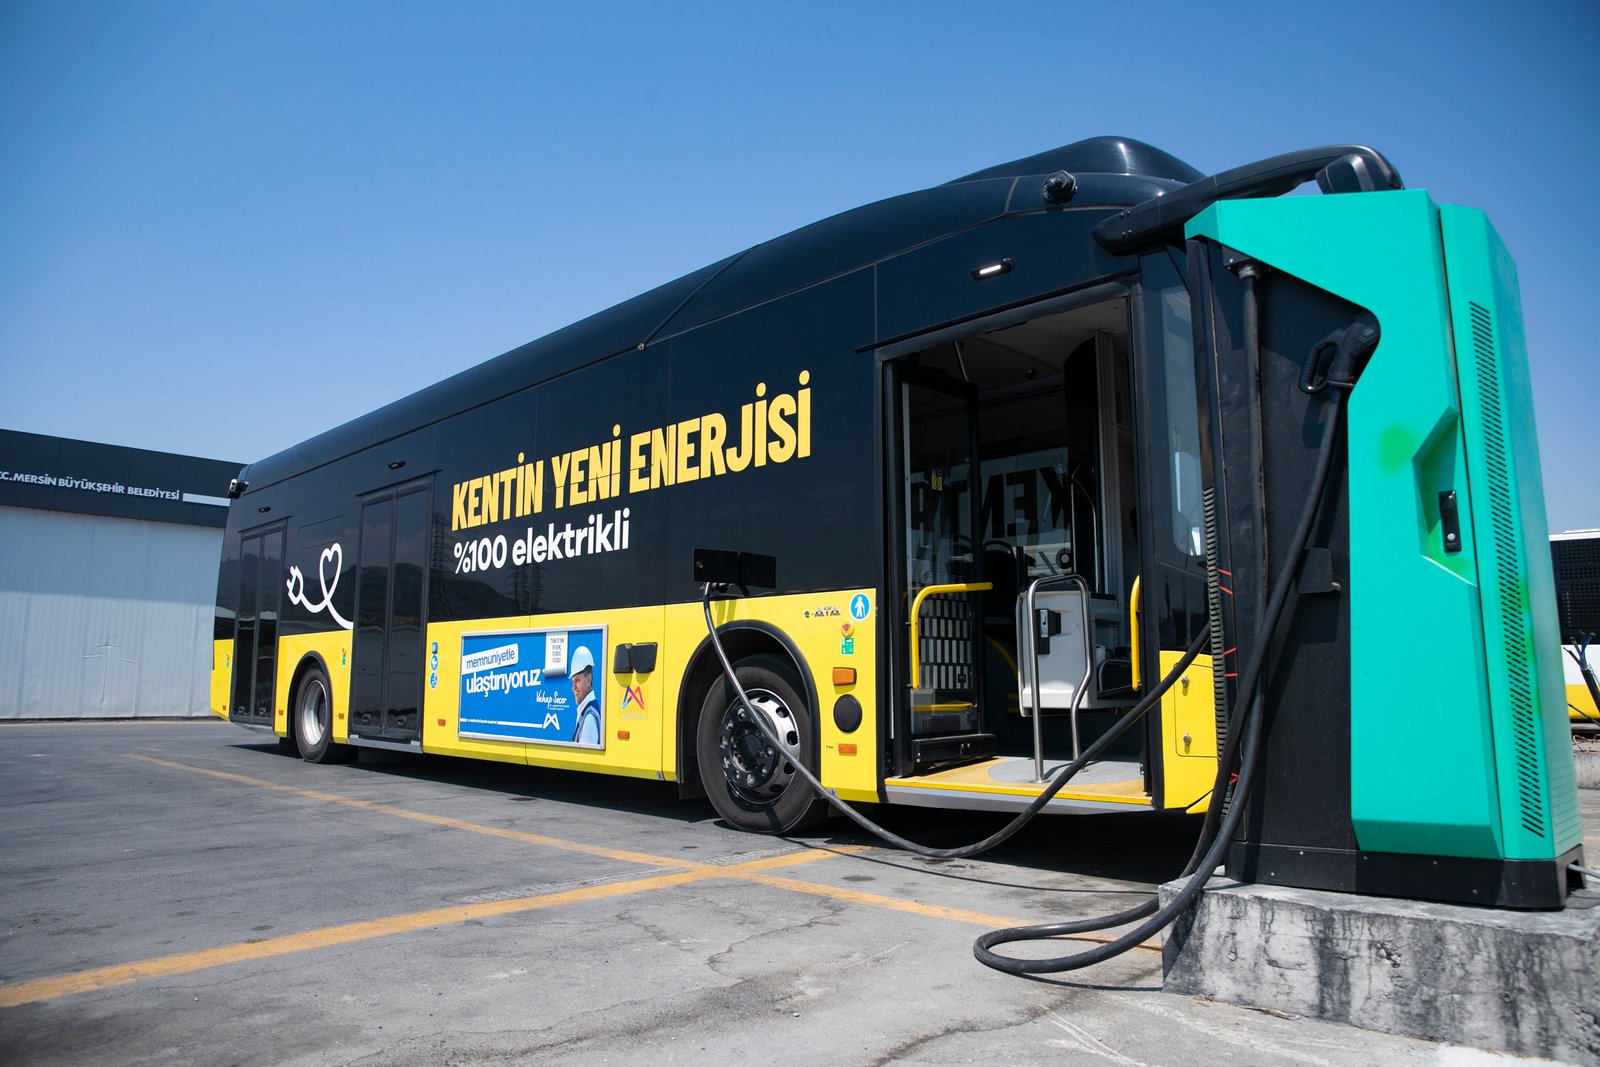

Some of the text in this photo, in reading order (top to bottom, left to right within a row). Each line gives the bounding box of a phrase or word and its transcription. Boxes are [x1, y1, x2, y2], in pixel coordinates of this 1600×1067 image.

[451, 369, 811, 532] KENTİN YENİ ENERJİSİ
[58, 476, 125, 494] BÜYÜKŞEHİR
[127, 486, 181, 500] BELEDİYESİ
[454, 507, 631, 575] %100 elektrikli
[466, 648, 516, 670] memnuniyetle
